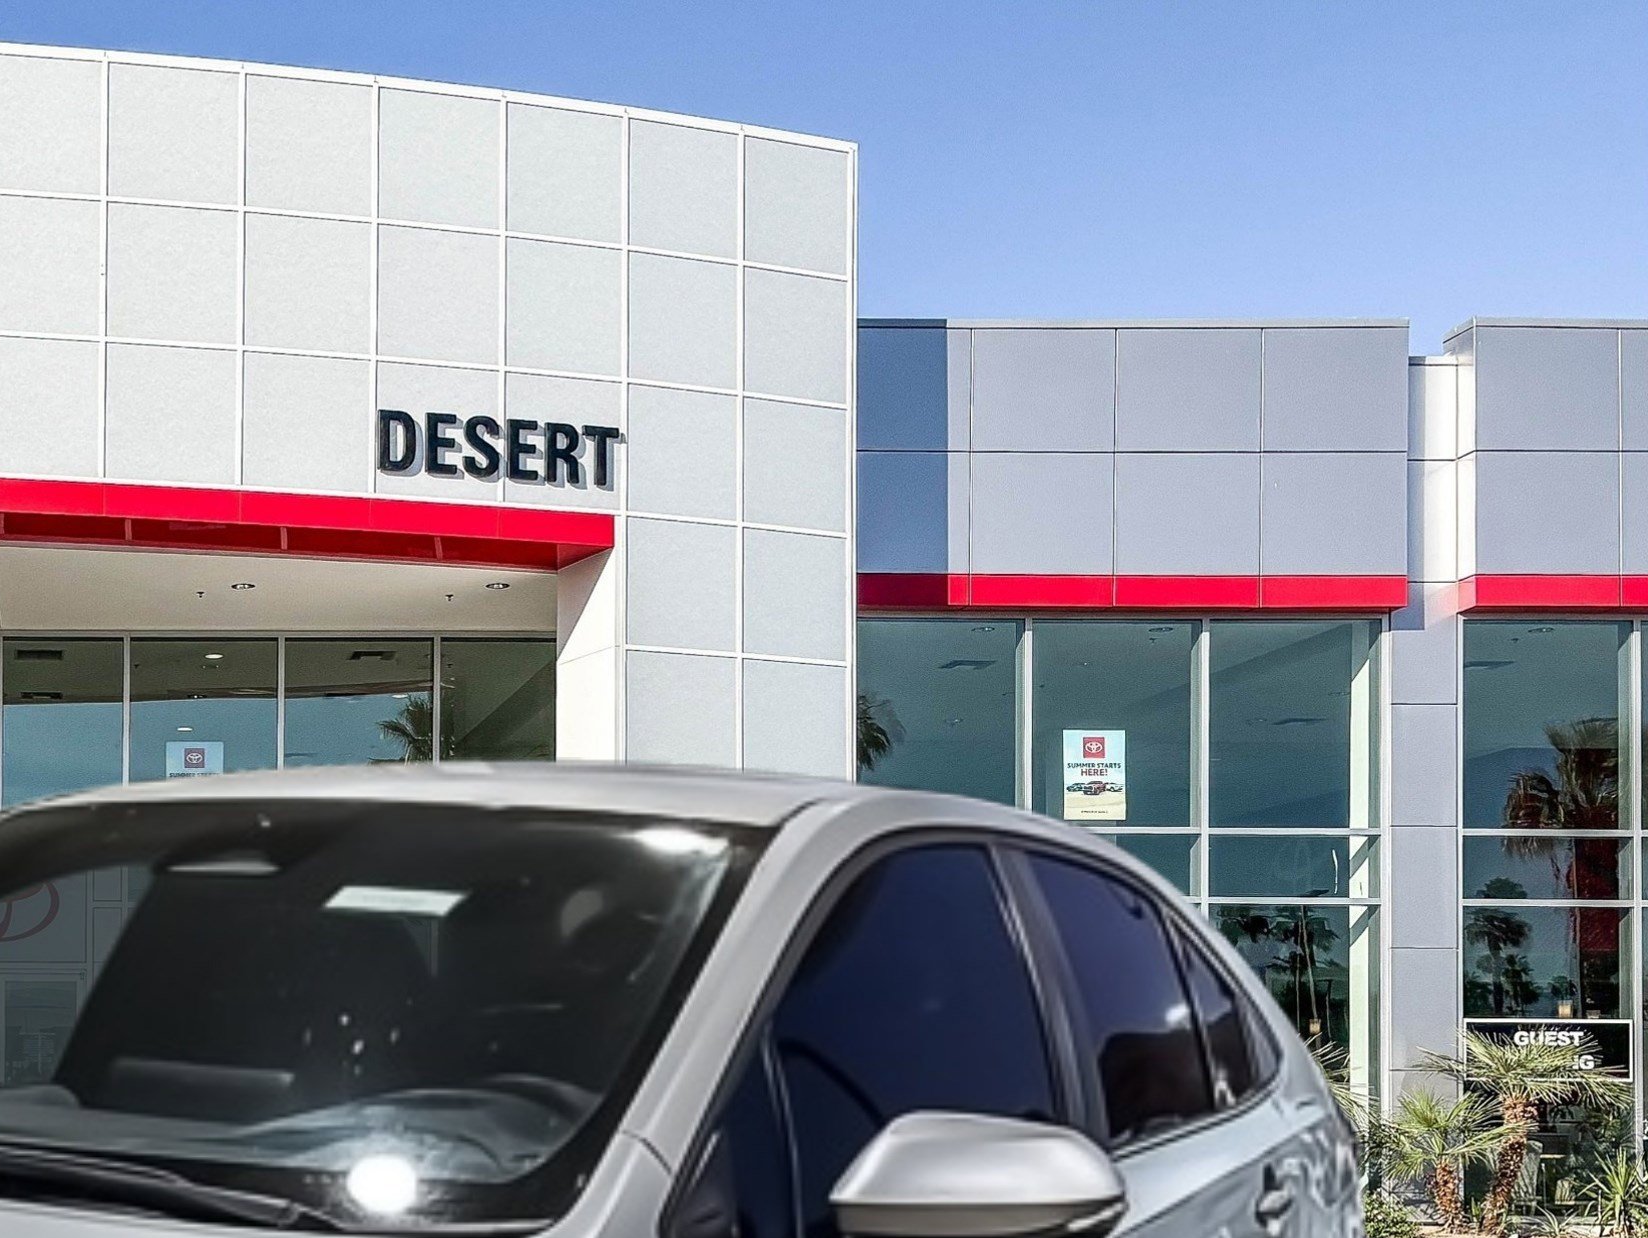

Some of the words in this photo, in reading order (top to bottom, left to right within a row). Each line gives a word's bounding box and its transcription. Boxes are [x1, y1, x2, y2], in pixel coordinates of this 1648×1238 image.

[377, 408, 620, 487] DESERT
[1080, 768, 1108, 776] HERE!
[1513, 1030, 1585, 1047] GUEST
